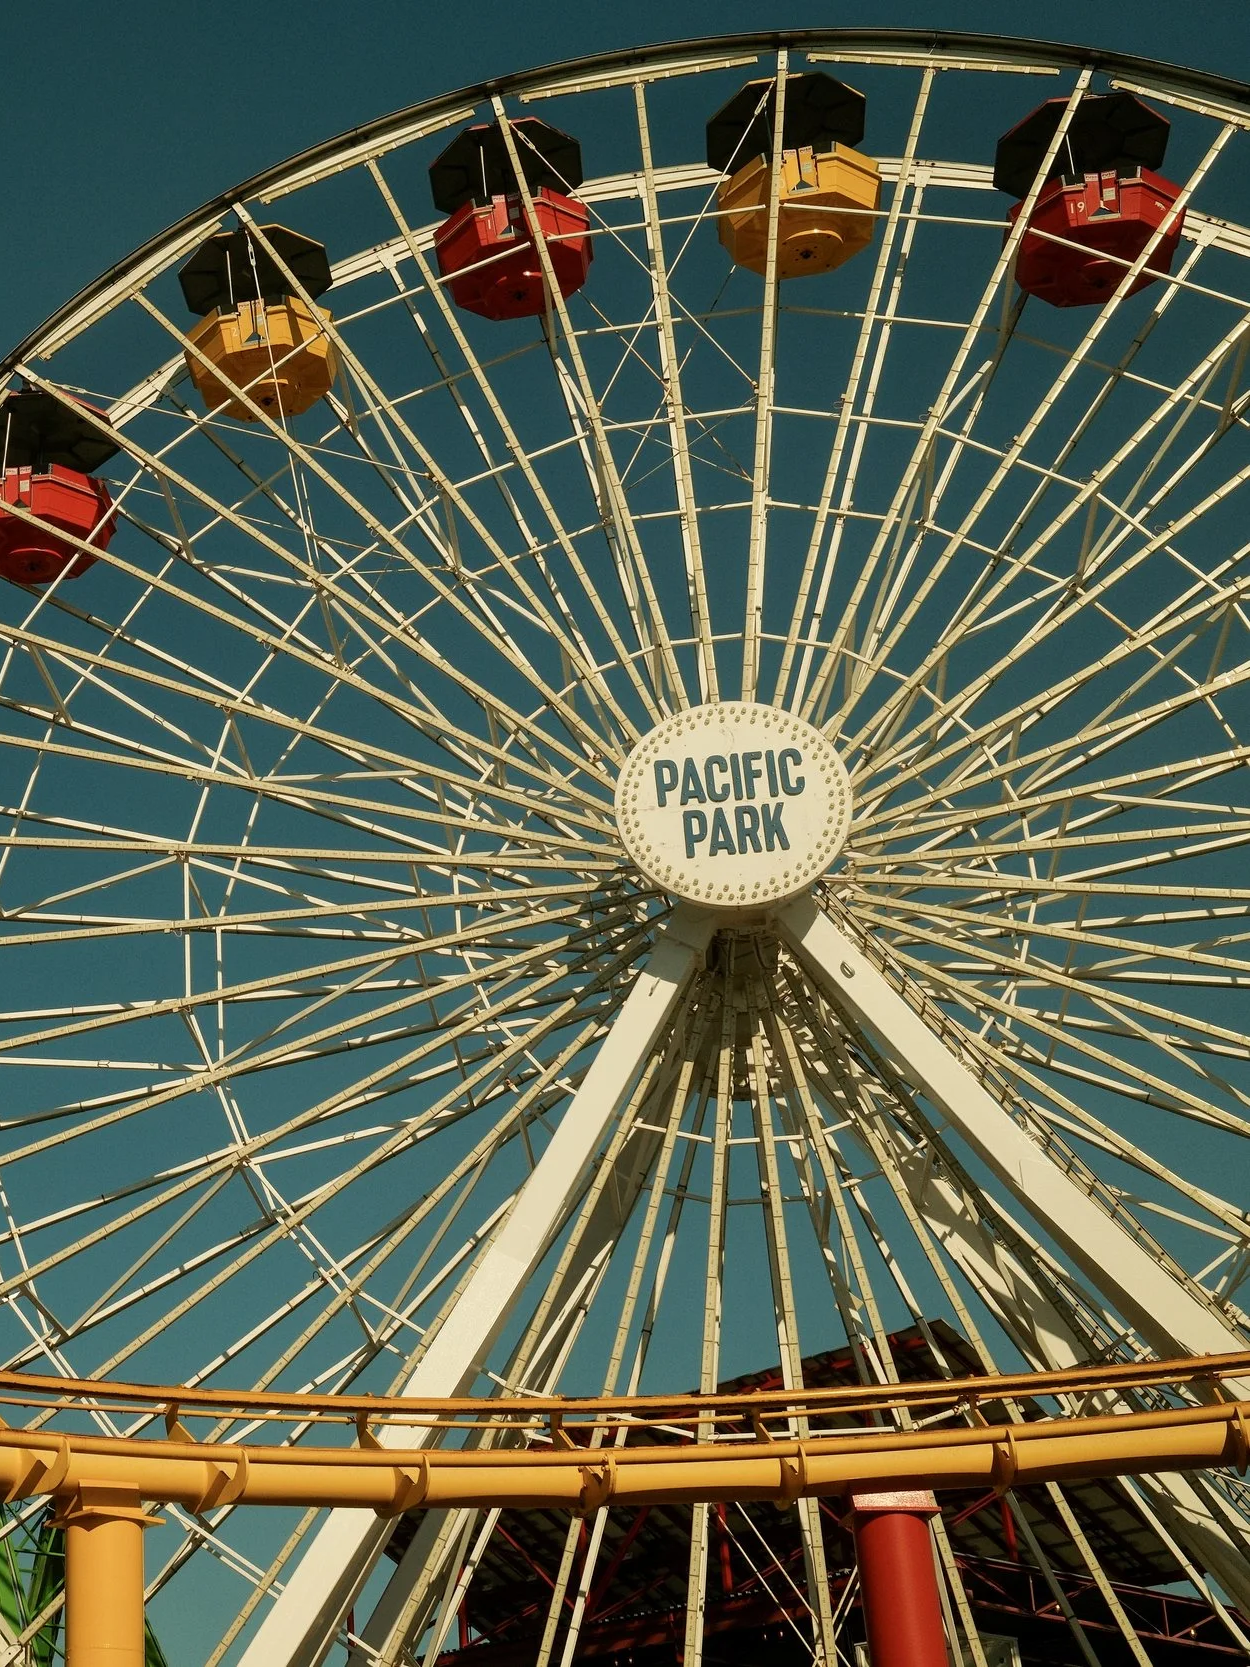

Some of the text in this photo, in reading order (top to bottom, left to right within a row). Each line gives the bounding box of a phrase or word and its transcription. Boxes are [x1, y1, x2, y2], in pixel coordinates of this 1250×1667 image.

[1070, 201, 1085, 213] 19
[653, 747, 805, 807] PACIFIC
[682, 801, 790, 859] PARK
